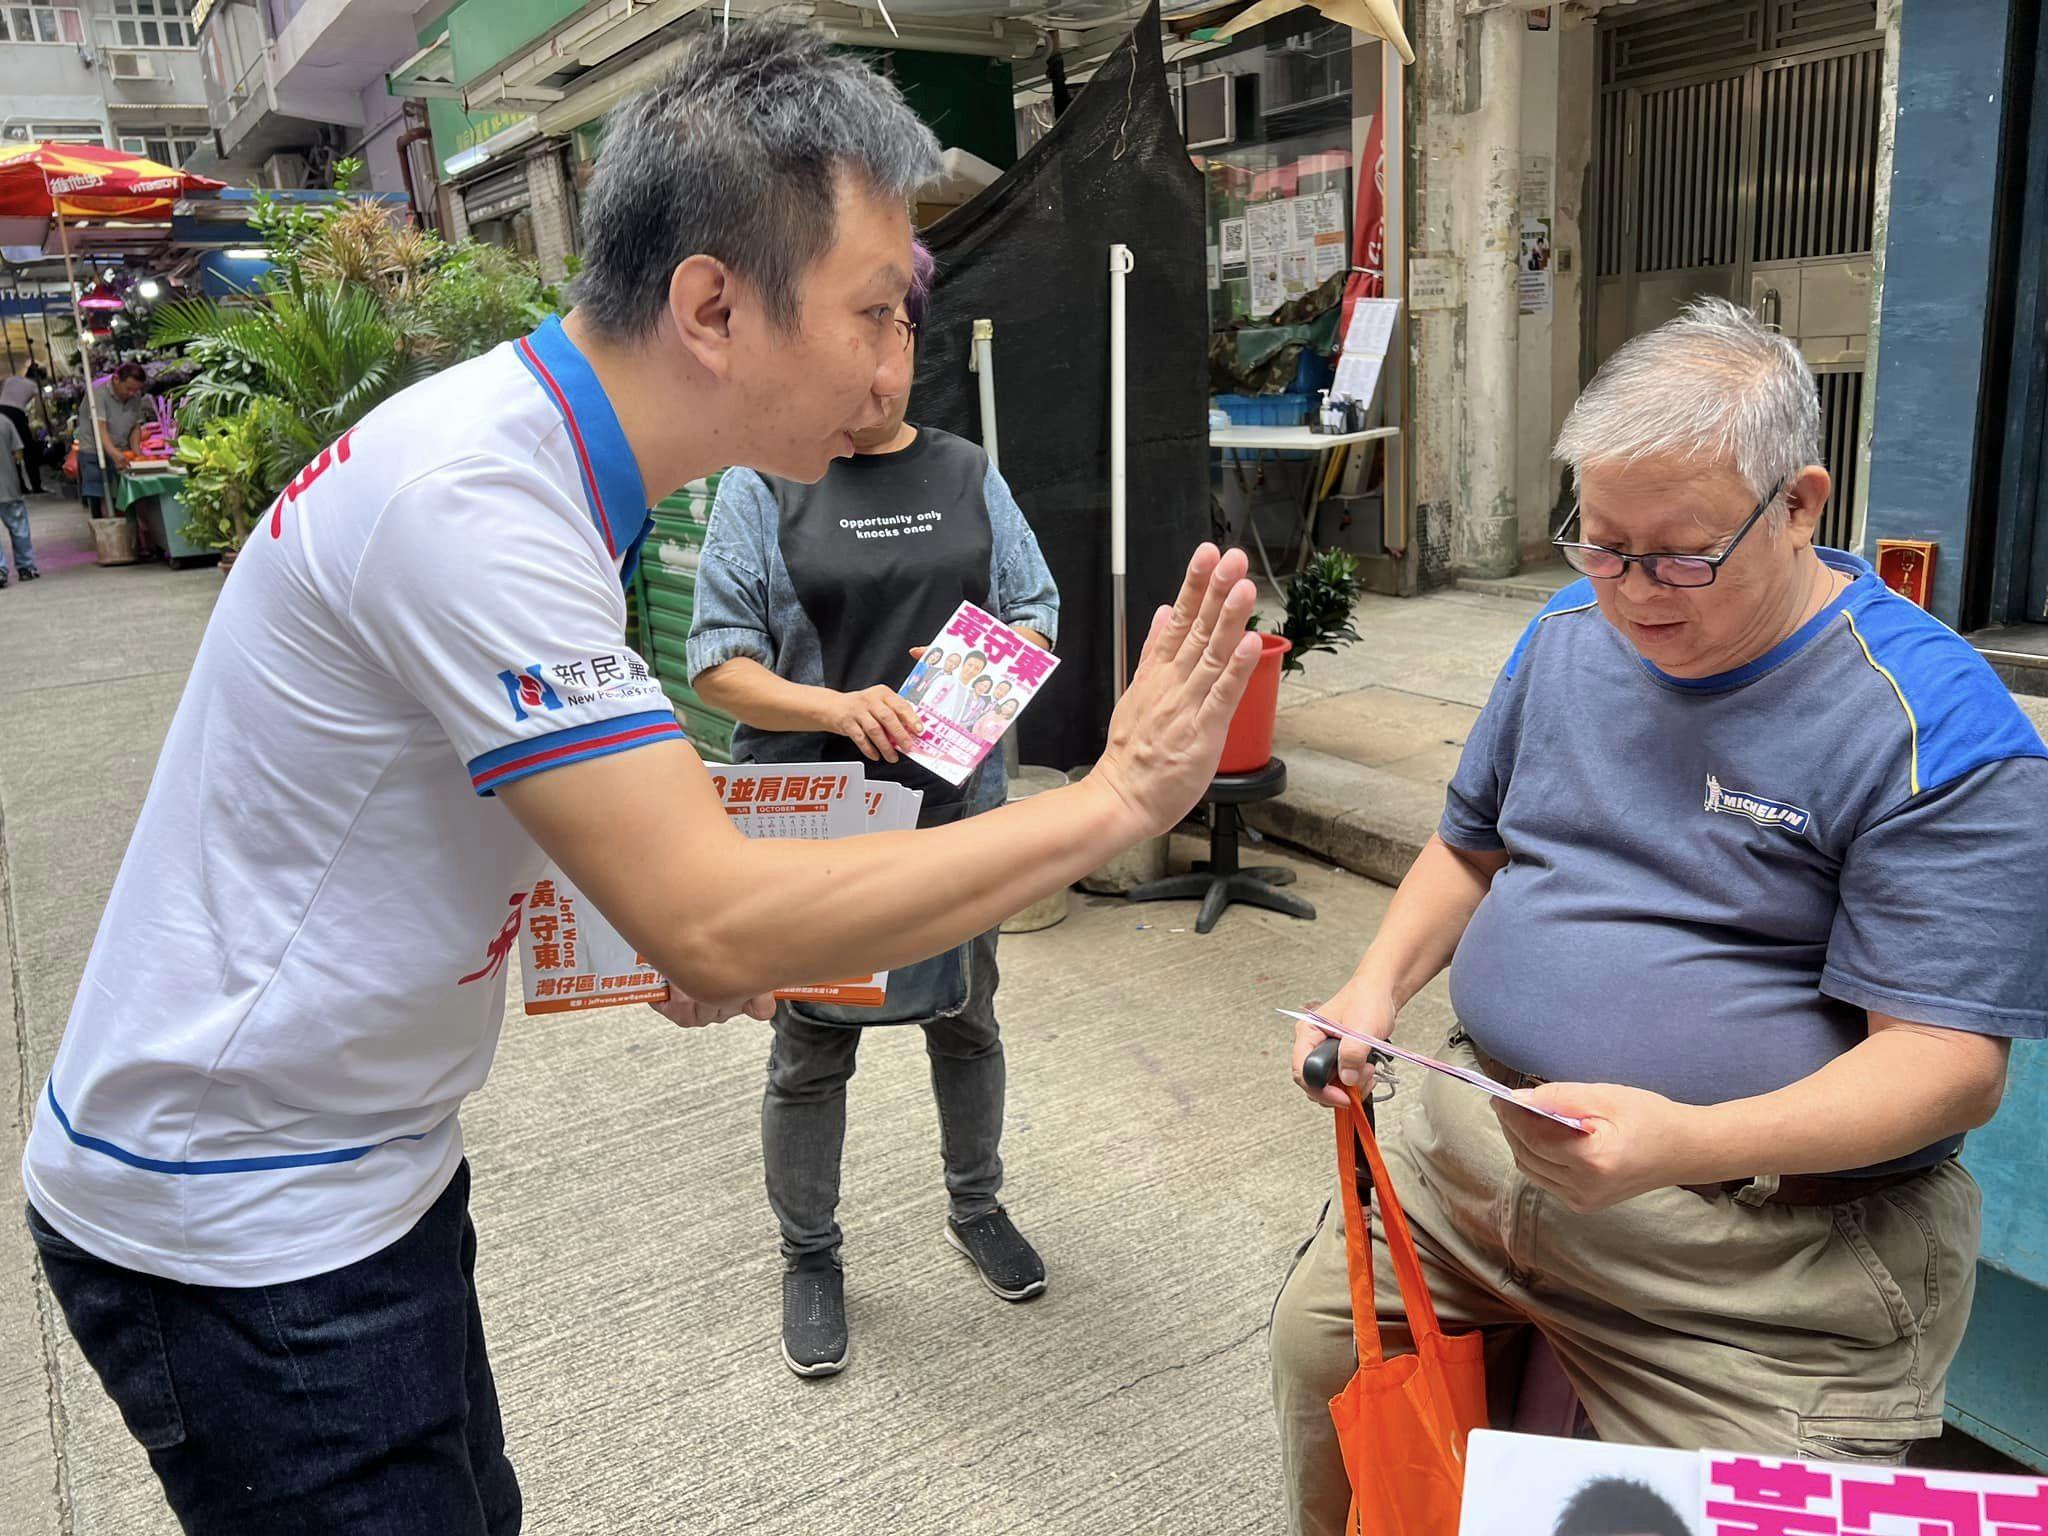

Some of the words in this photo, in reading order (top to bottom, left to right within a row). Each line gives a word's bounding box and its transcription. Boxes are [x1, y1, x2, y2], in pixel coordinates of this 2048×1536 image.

[839, 514, 912, 529] Opportunity
[916, 510, 942, 521] only
[855, 528, 900, 539] knocks
[903, 523, 933, 535] once
[567, 693, 596, 707] New
[1724, 794, 1804, 826] MICHELIN
[559, 896, 576, 925] Jeff
[562, 927, 577, 968] Wong
[535, 974, 596, 997] 灣仔區
